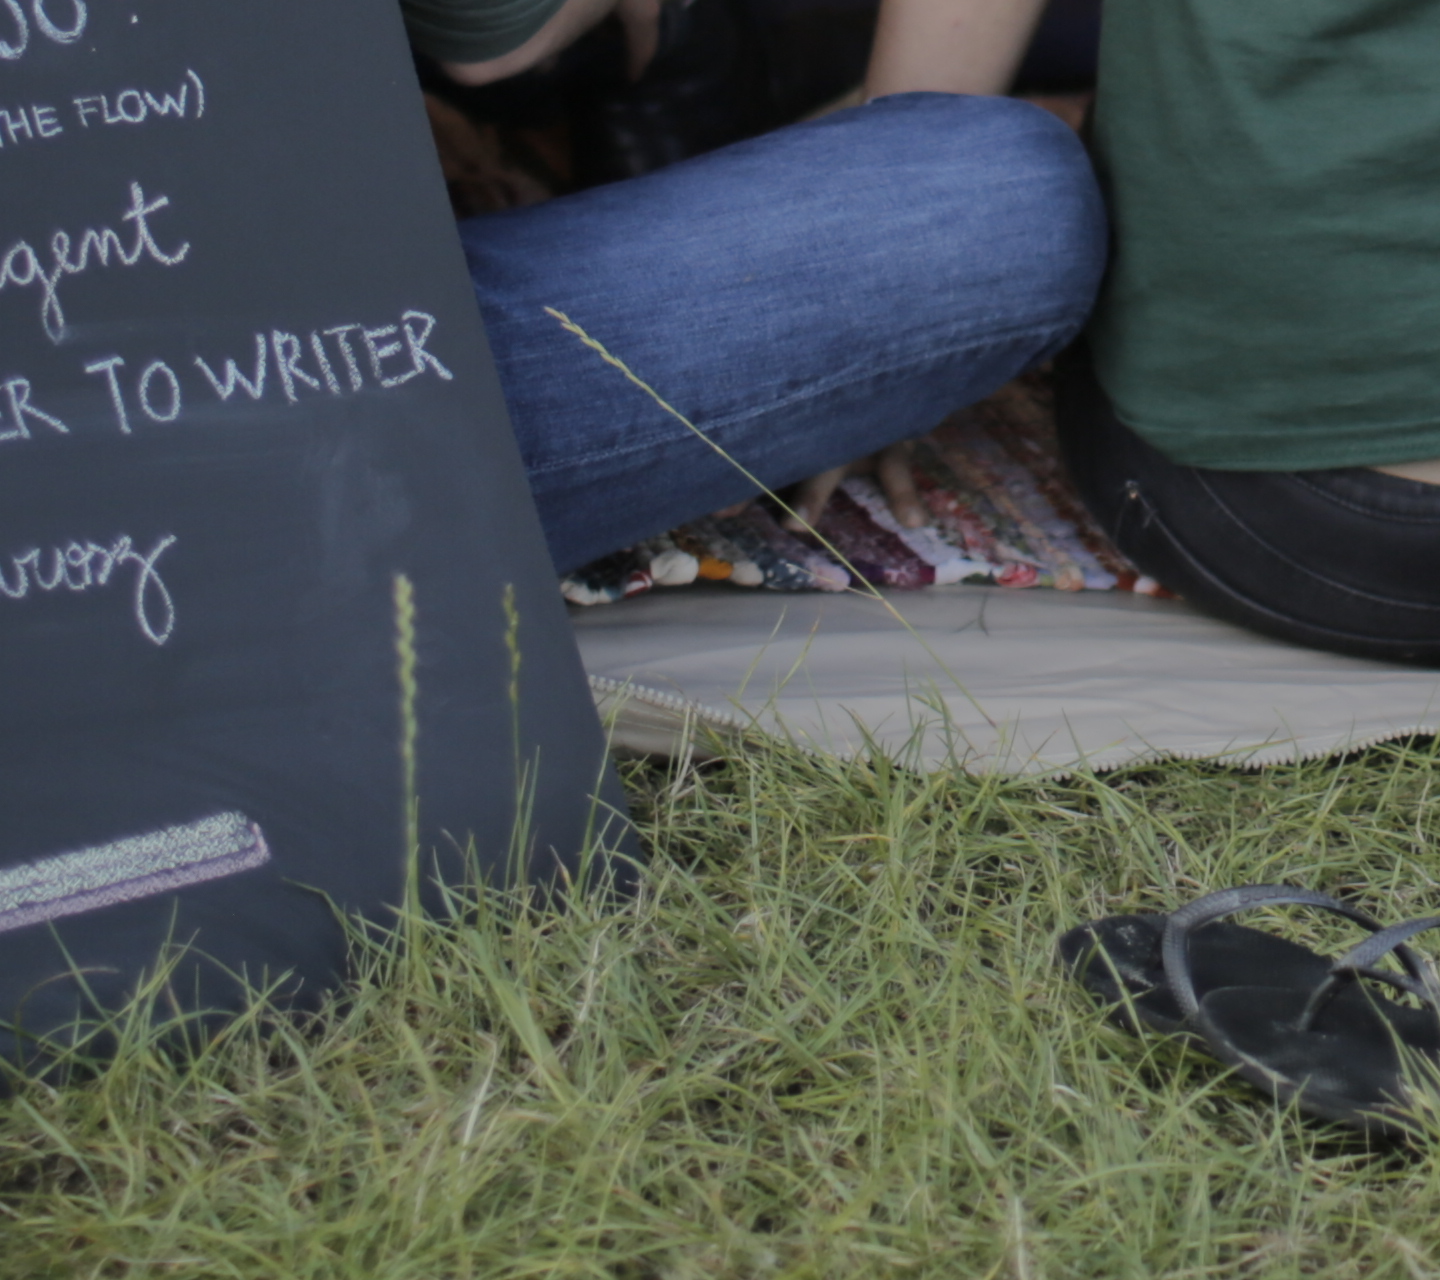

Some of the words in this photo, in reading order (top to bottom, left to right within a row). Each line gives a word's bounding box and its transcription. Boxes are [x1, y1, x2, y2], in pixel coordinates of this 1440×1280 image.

[73, 69, 206, 128] FLOW)
[85, 355, 182, 434] TO
[194, 311, 454, 404] WRITER
